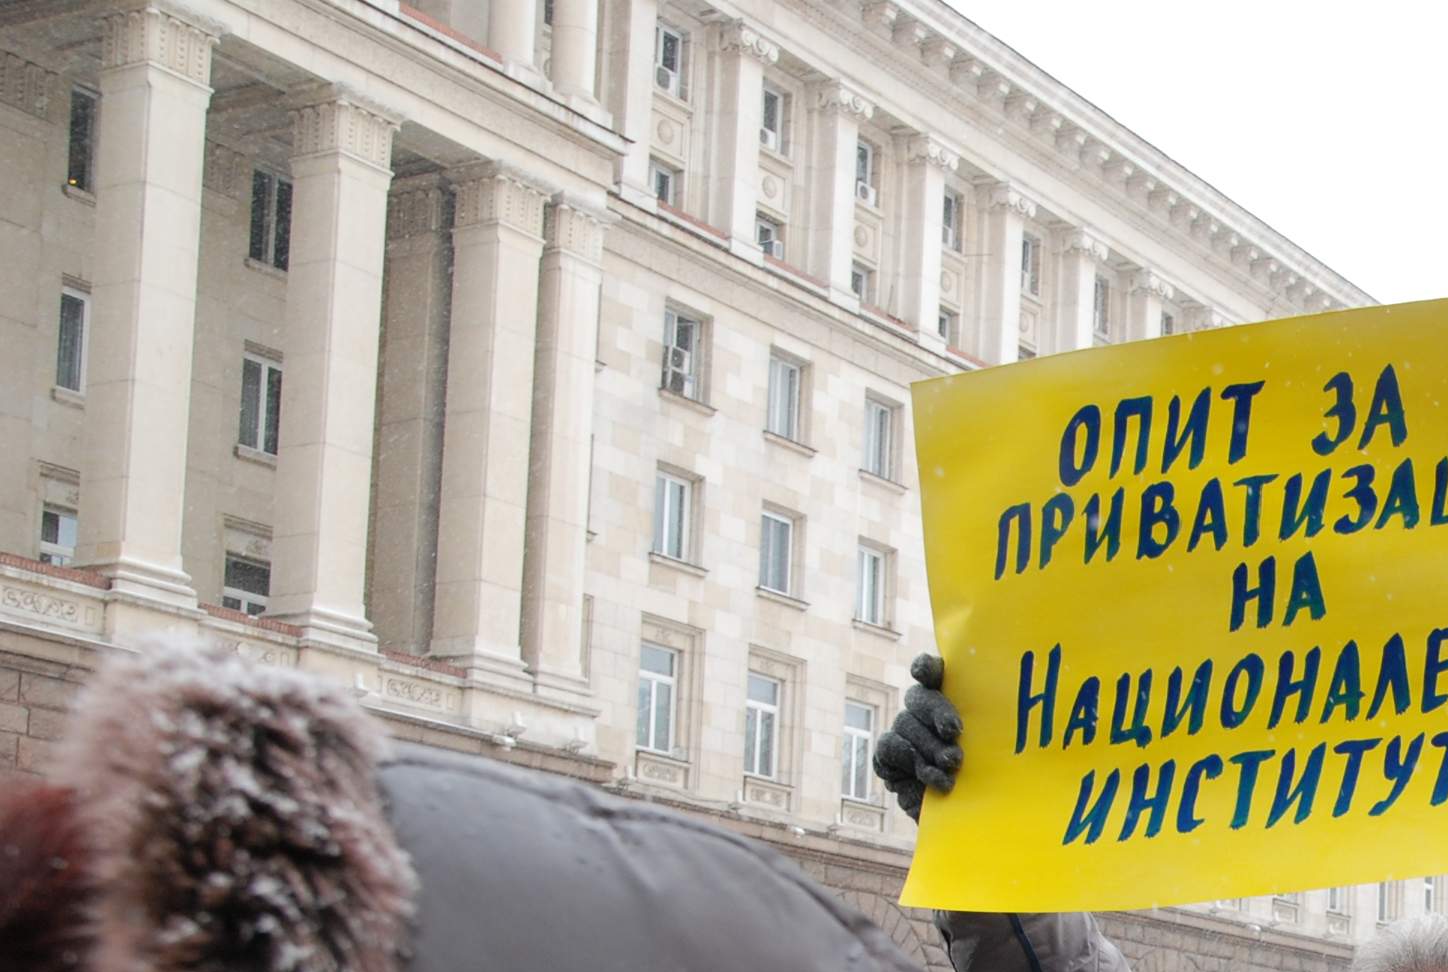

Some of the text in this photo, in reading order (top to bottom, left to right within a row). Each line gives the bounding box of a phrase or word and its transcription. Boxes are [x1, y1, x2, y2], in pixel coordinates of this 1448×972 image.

[1060, 366, 1407, 487] ОПИТ ЗА
[1231, 552, 1325, 631] НА
